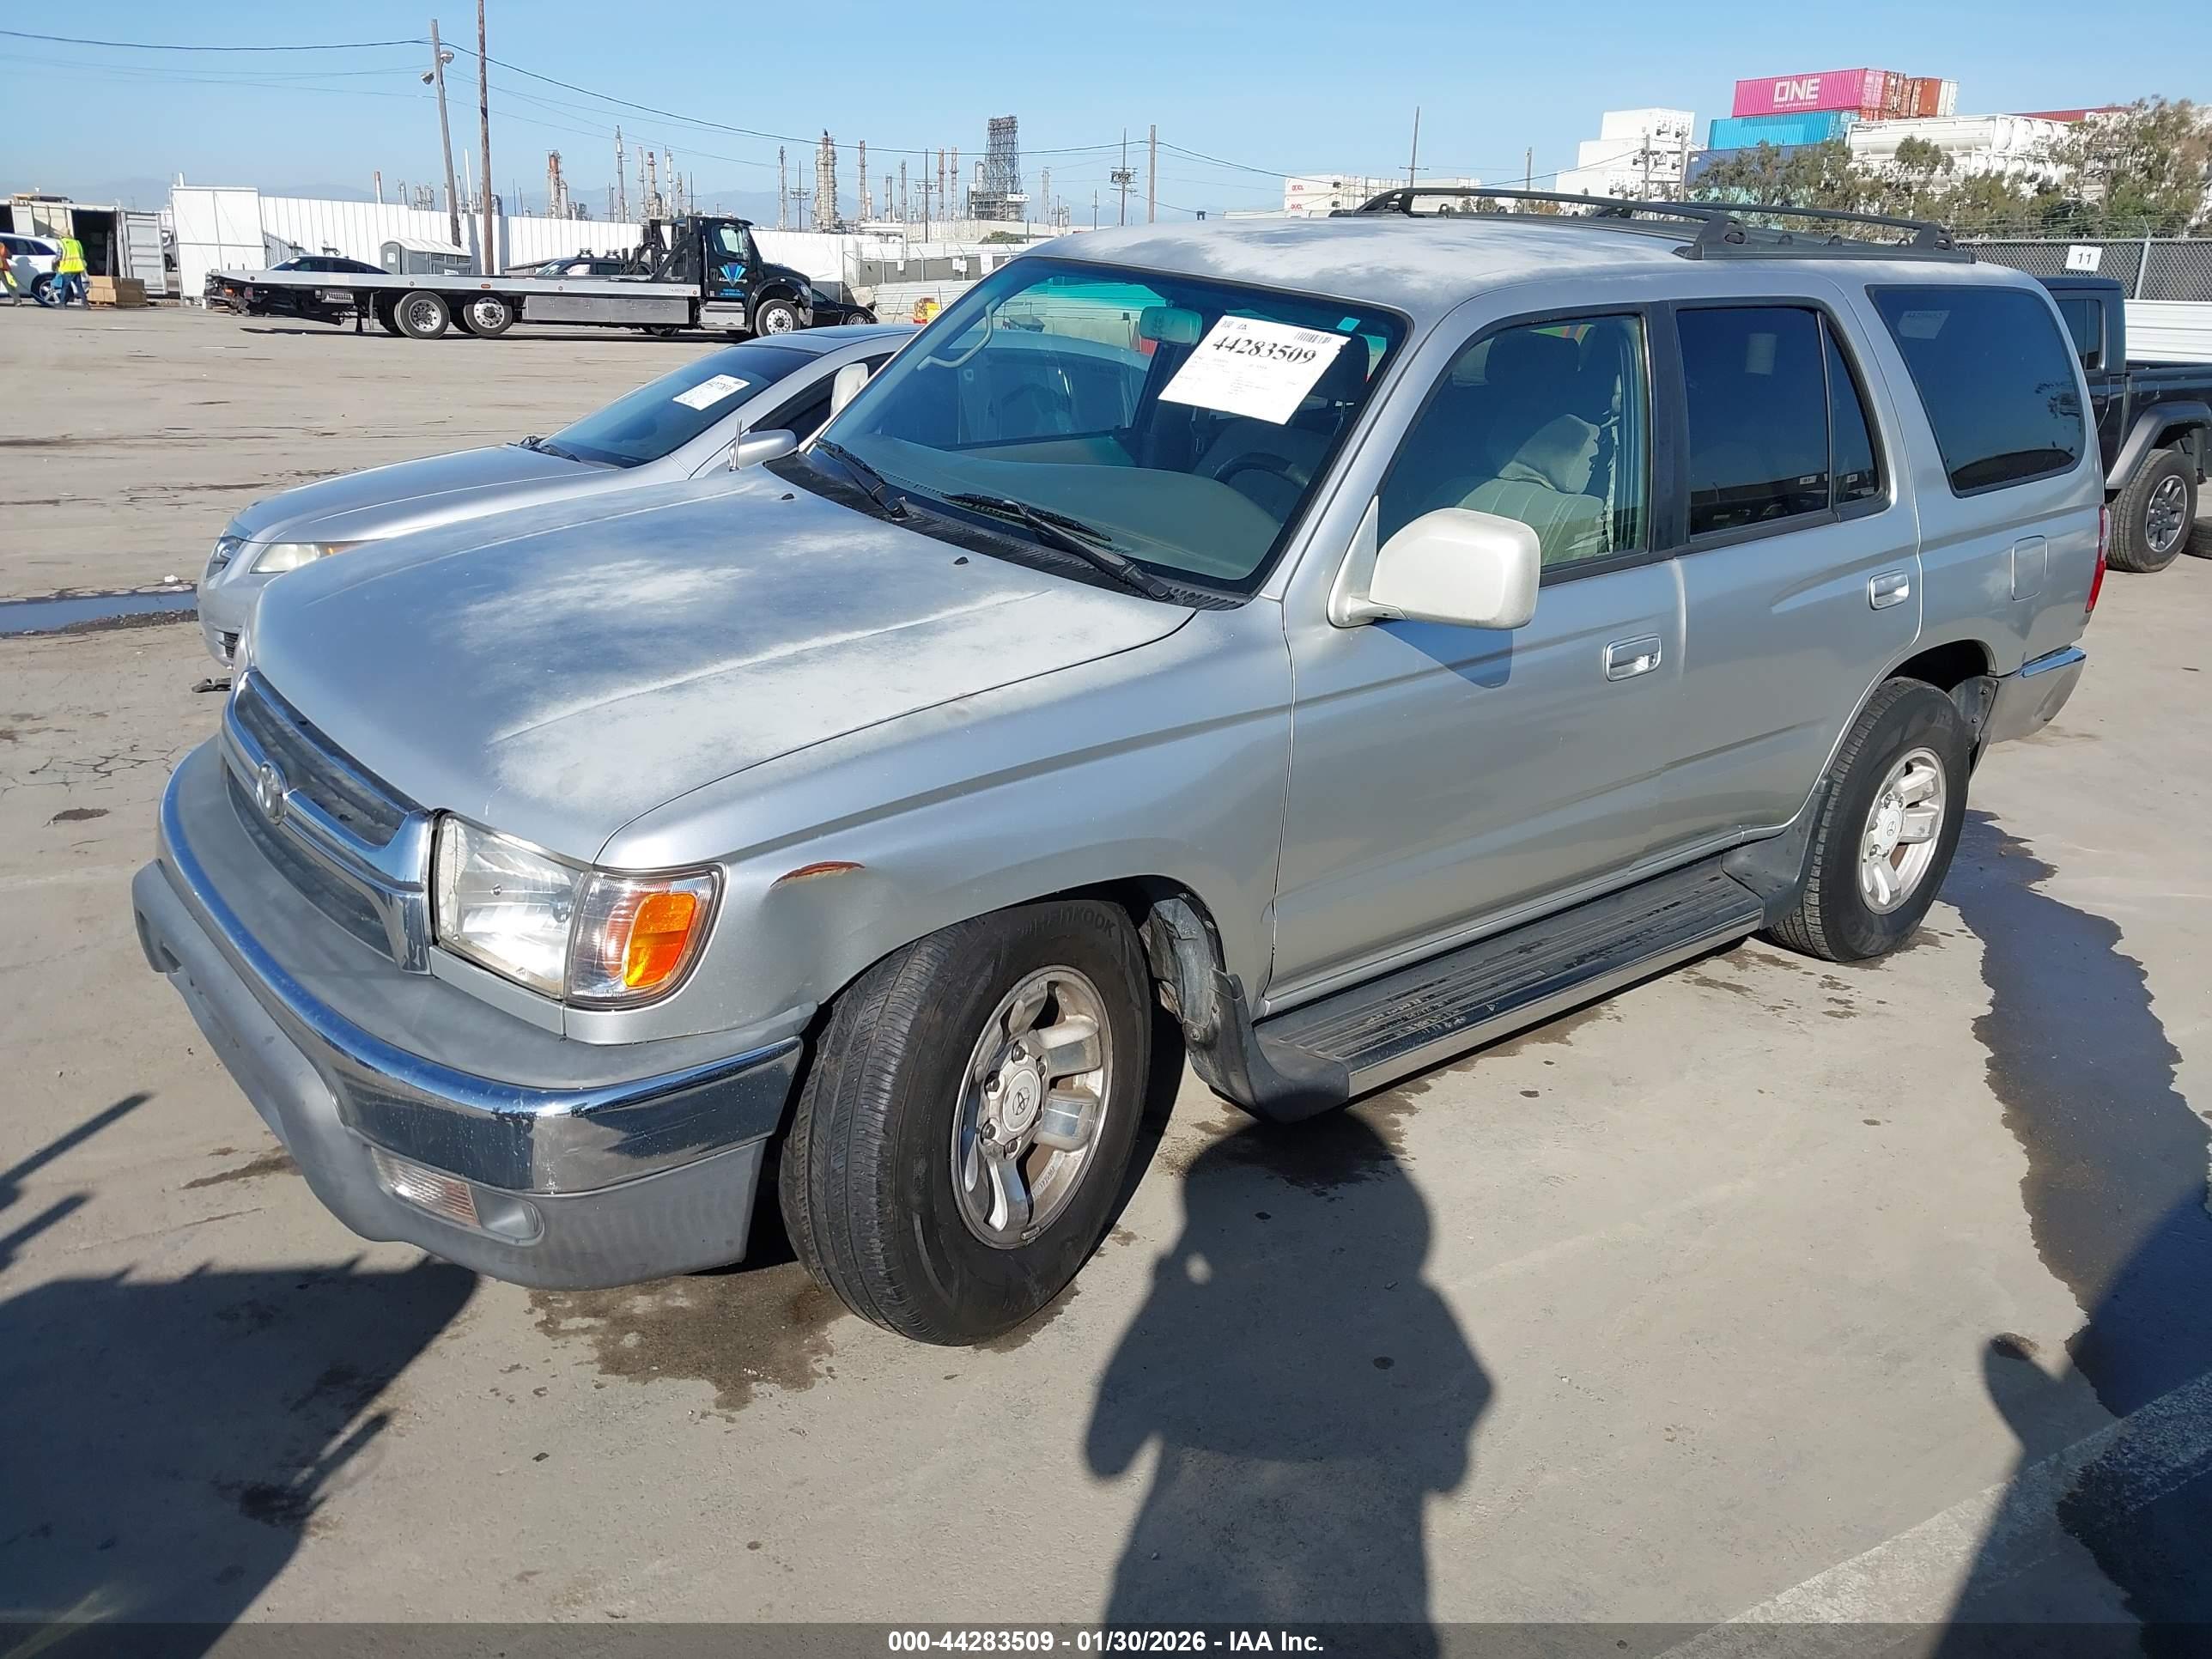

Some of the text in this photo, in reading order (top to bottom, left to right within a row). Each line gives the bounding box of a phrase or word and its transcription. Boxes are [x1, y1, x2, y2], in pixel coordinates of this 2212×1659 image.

[1773, 78, 1820, 103] ONE
[2078, 252, 2092, 264] 11
[1212, 335, 1317, 365] 44283509
